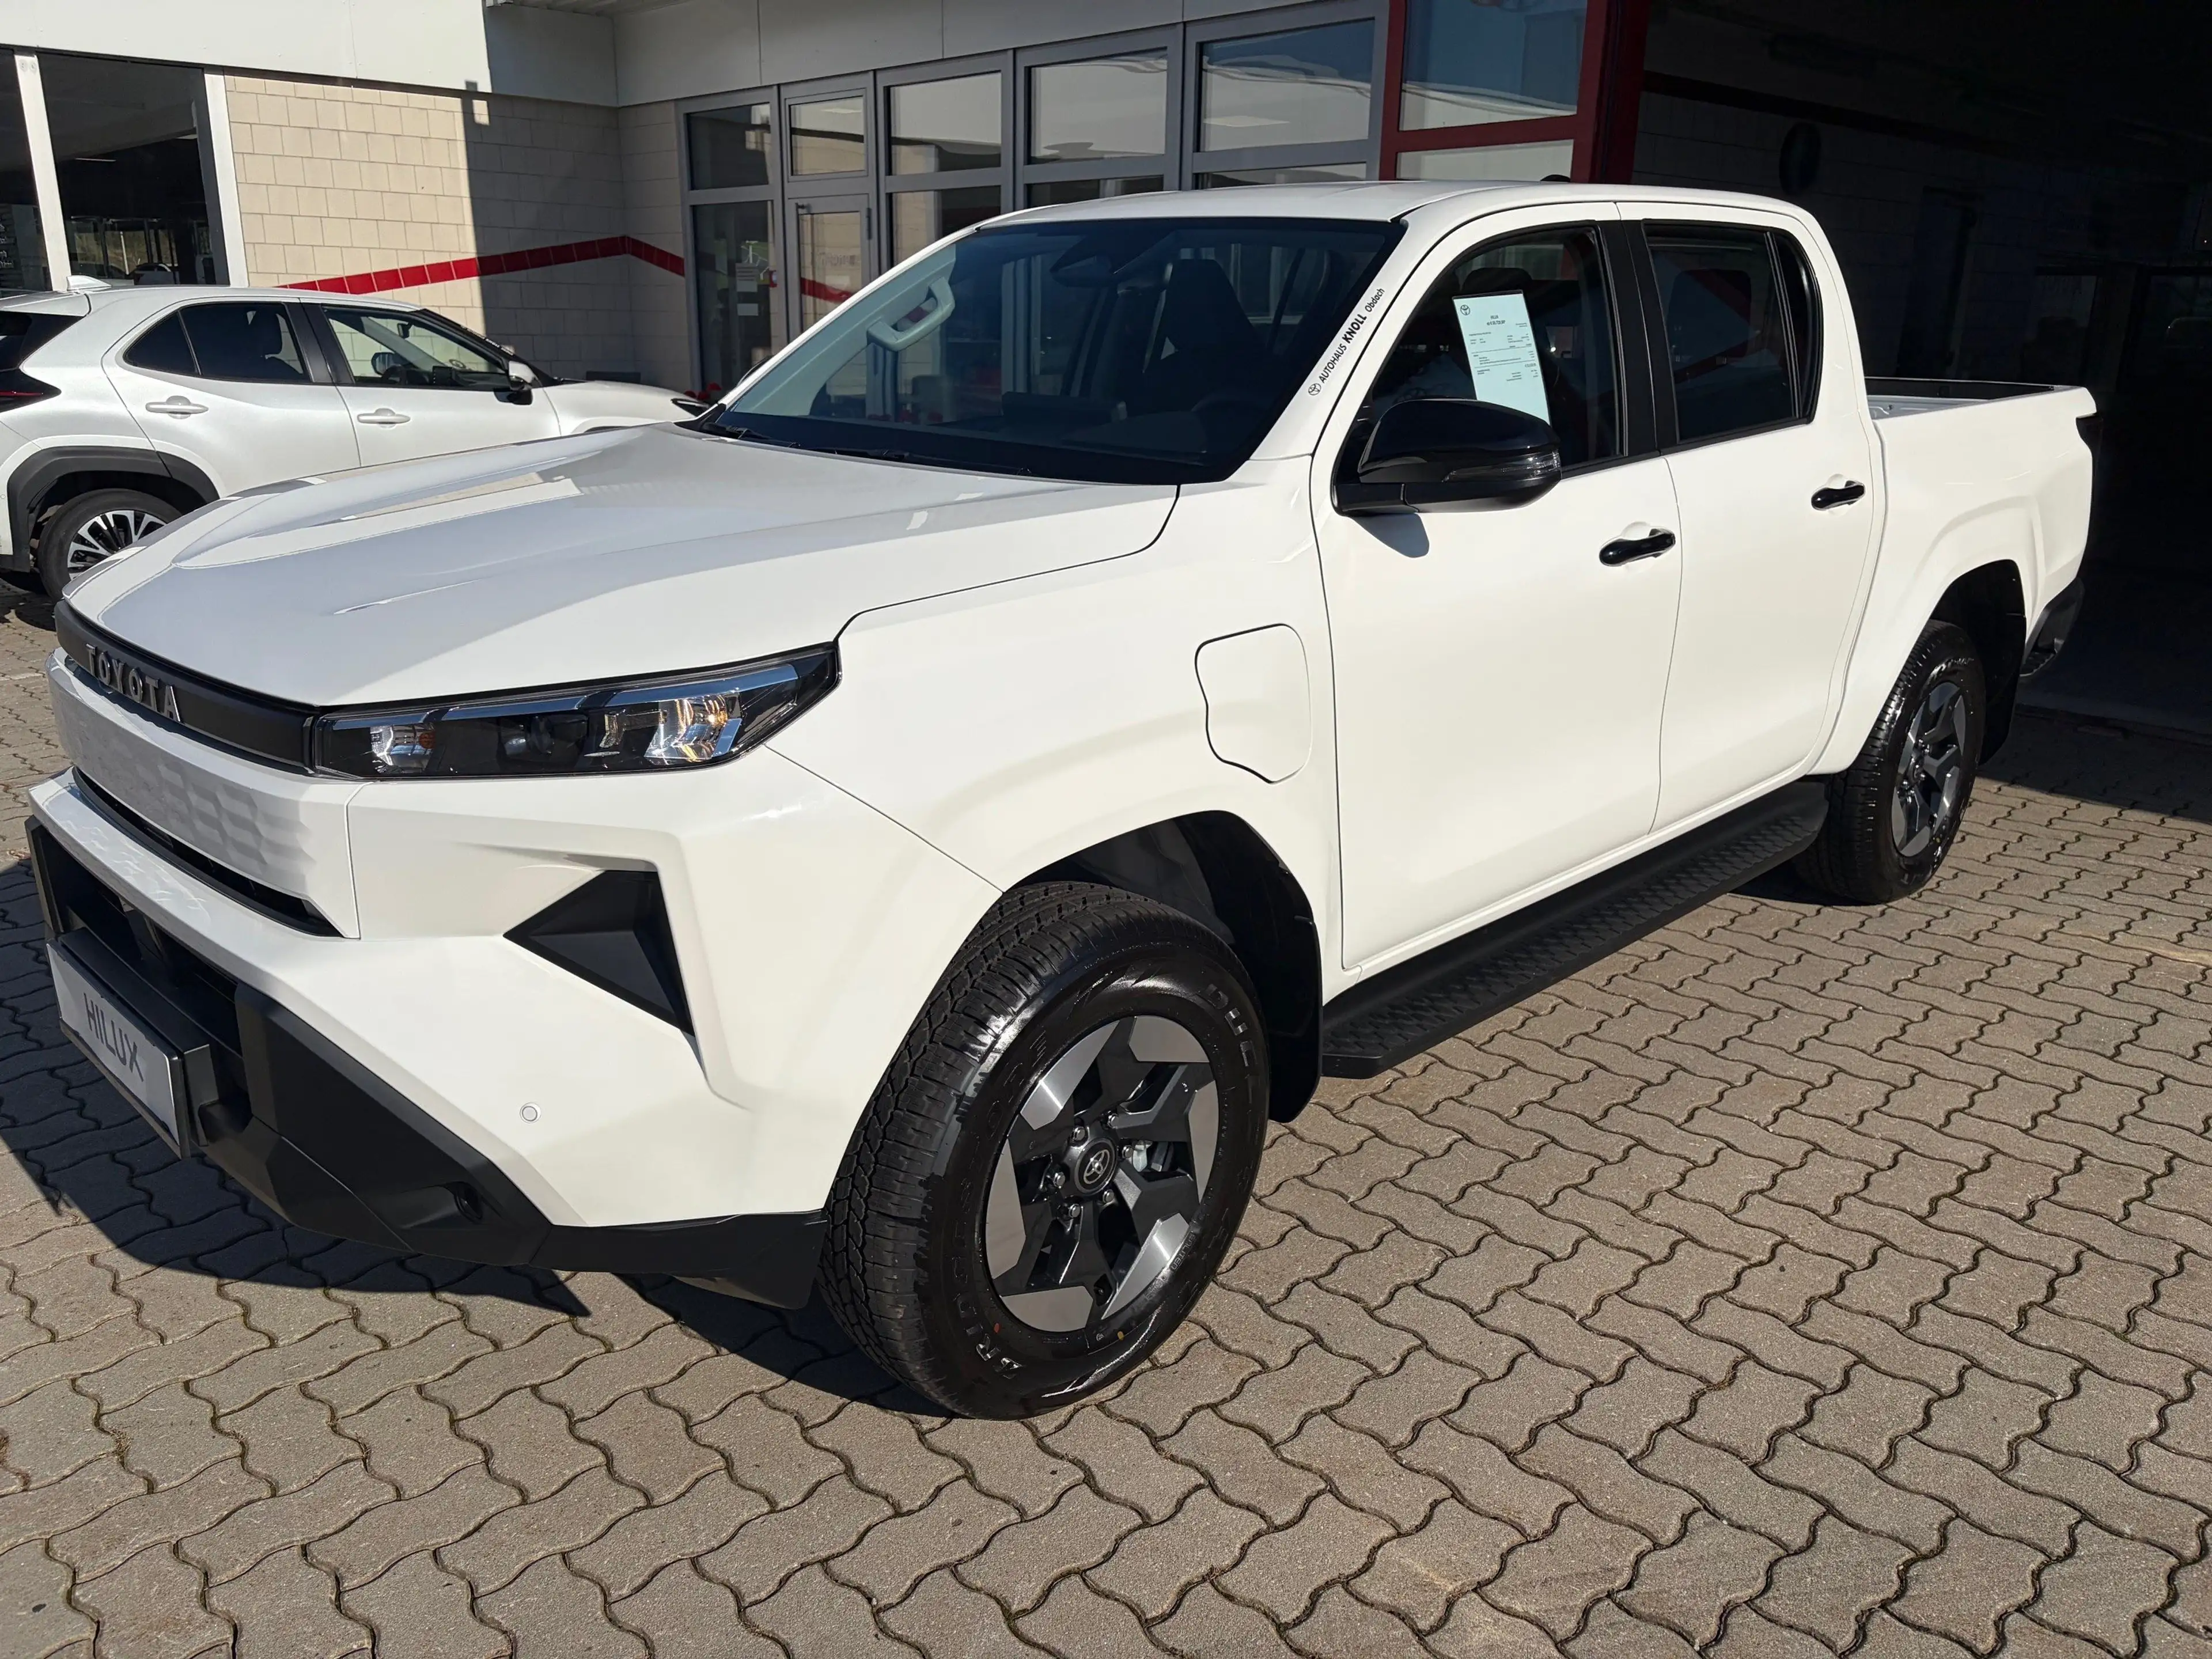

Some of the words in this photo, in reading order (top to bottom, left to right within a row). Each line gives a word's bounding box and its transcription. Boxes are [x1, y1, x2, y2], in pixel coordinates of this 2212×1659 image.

[1318, 343, 1347, 384] AUTOHAUS
[1342, 313, 1367, 344] KNOLL
[1365, 287, 1385, 313] Obdach
[86, 643, 181, 722] TOYOTA
[84, 993, 144, 1082] HILUX
